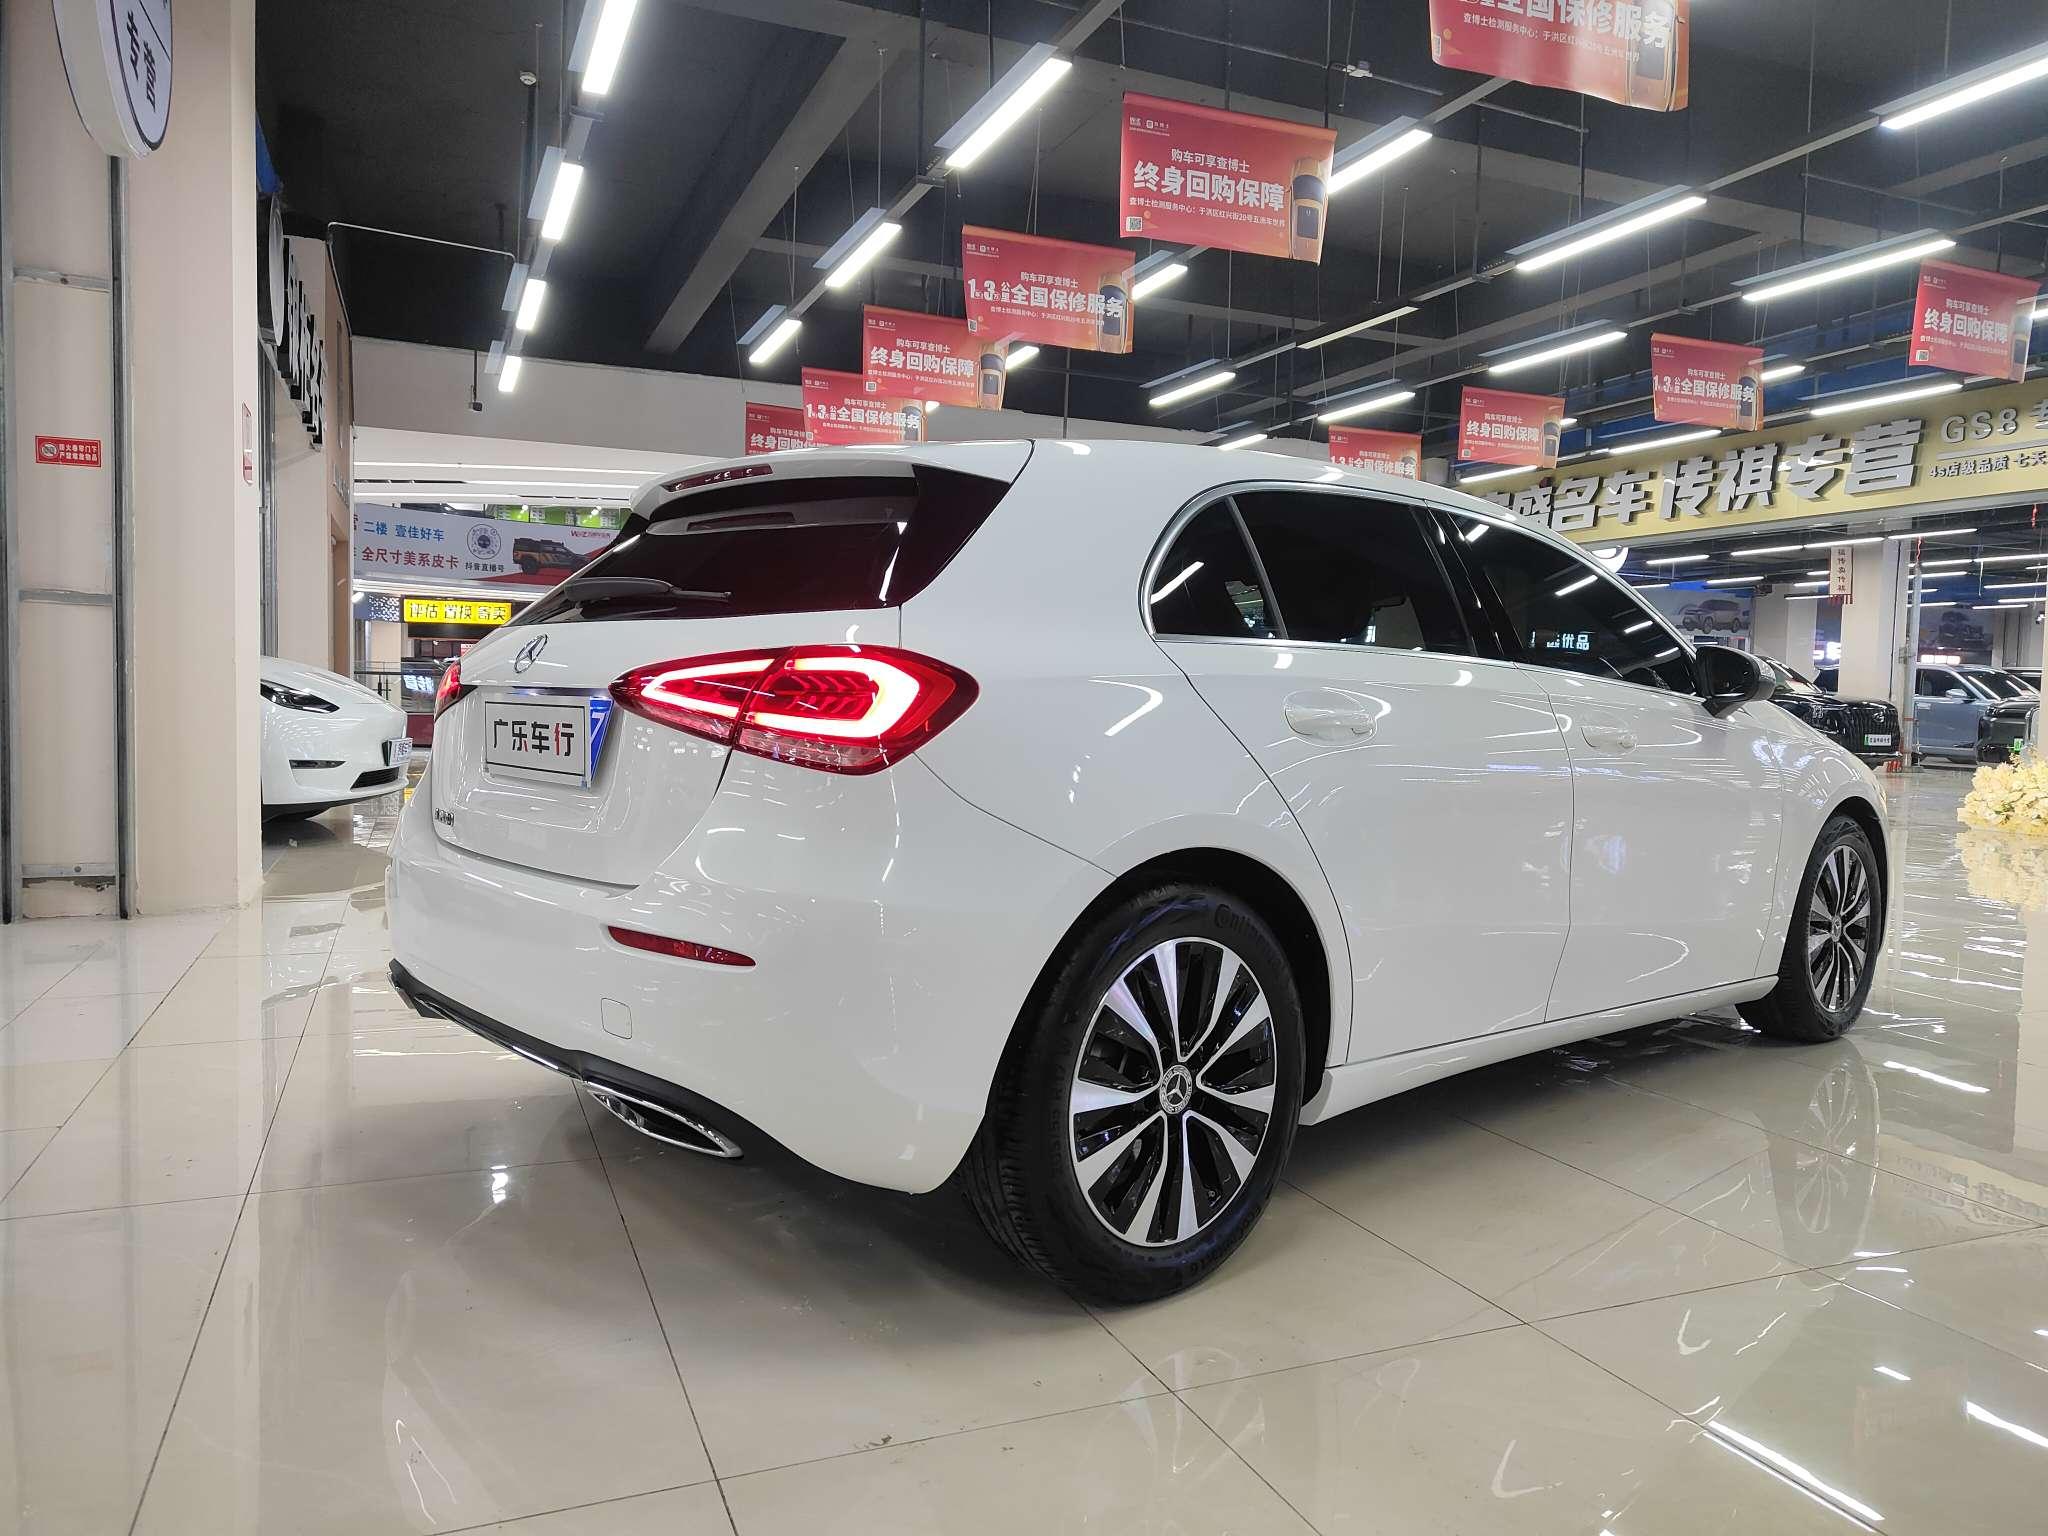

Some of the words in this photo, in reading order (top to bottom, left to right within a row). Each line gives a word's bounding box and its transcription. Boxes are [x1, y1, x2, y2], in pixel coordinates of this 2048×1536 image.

[1171, 148, 1250, 174] 购车可享查博士
[1133, 160, 1285, 212] 终身回购保障
[1020, 271, 1079, 289] 购车可享查博士
[1923, 307, 2009, 344] 终身回购保障
[896, 338, 951, 354] 购车可享查博士
[870, 346, 975, 378] 终身回购保障
[1466, 420, 1539, 442] 终身回购保障
[1941, 407, 2019, 444] GS8
[751, 433, 808, 450] 终身回购
[1484, 417, 1923, 533] 盛名车传祺专营
[363, 521, 388, 536] 二楼
[394, 524, 445, 542] 壹佳好车
[361, 546, 459, 570] 全尺寸美系皮卡
[410, 602, 438, 619] 评估
[493, 718, 575, 757] 广乐车行
